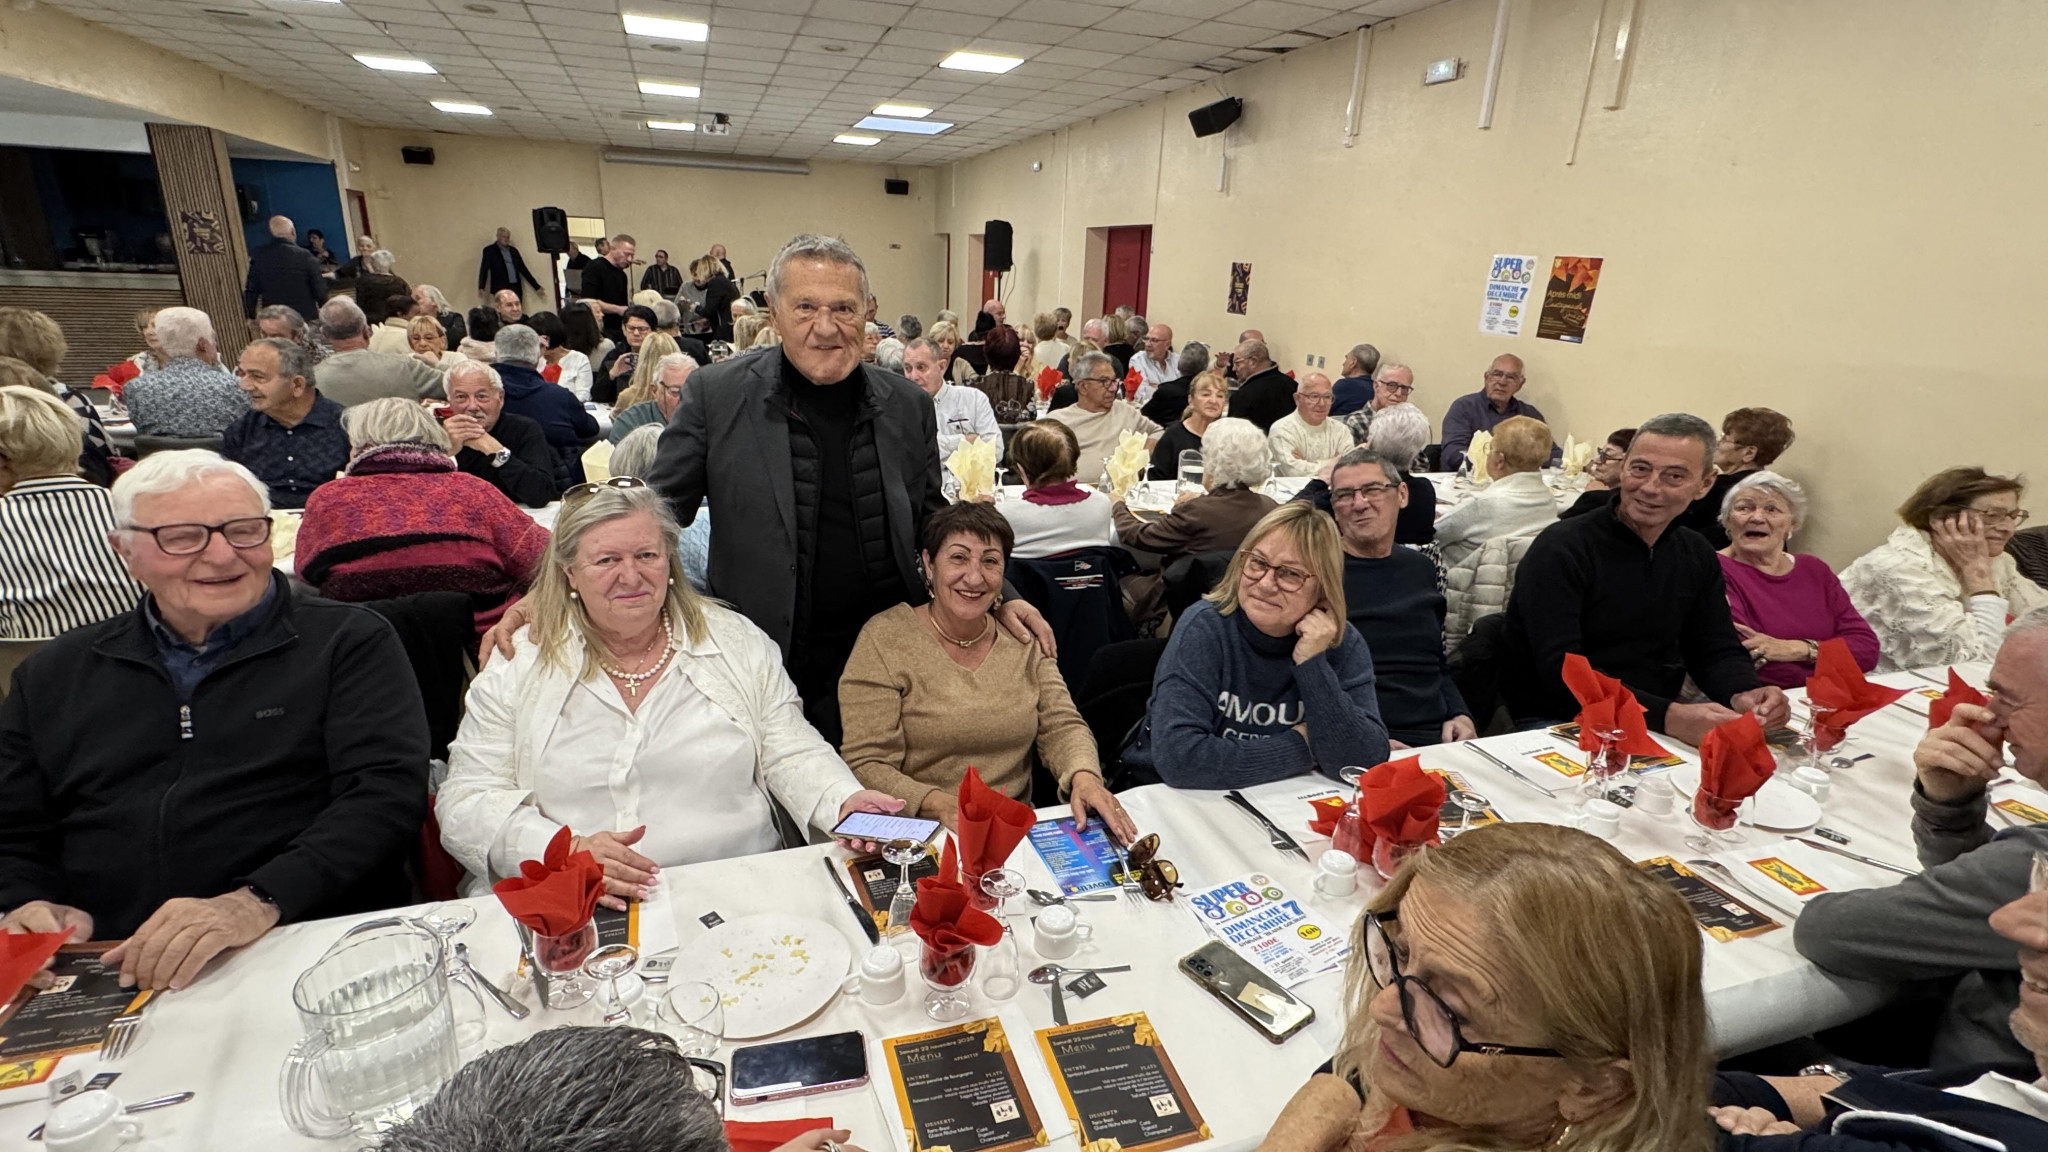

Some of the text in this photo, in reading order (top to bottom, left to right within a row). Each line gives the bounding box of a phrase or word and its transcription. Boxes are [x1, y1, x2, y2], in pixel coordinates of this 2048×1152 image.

[1494, 257, 1523, 270] SUPER
[1520, 287, 1528, 300] 7
[255, 707, 285, 719] BOSS
[1217, 690, 1304, 727] AMOU
[1191, 881, 1252, 910] SUPER
[1222, 905, 1282, 936] DIMANCHE
[1281, 900, 1304, 916] 7
[1229, 912, 1293, 944] DECEMBRE
[1300, 926, 1318, 938] 16h
[1251, 937, 1280, 952] 2100€
[930, 1041, 956, 1049] novembre
[1061, 1043, 1095, 1054] Menu
[907, 1052, 942, 1063] Menu
